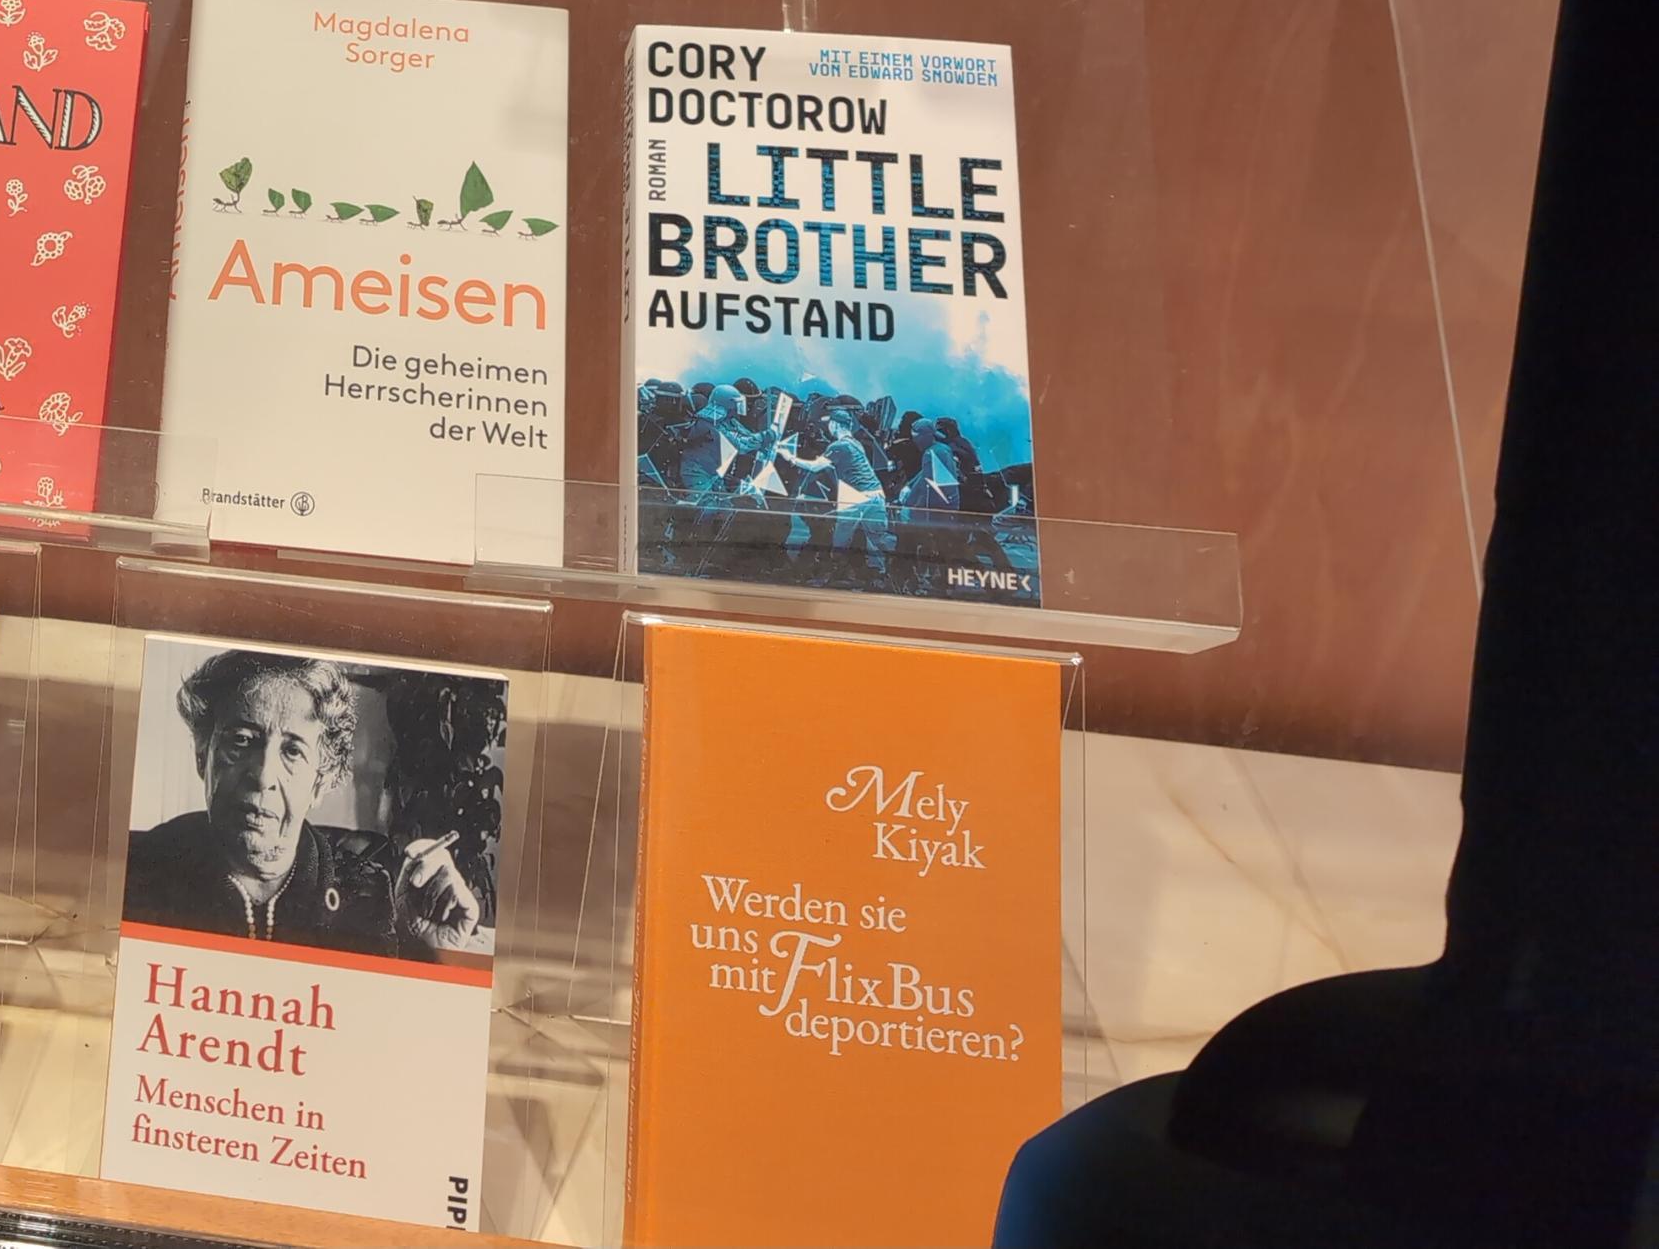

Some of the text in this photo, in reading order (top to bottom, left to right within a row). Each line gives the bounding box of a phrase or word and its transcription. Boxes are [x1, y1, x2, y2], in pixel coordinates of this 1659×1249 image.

[313, 10, 471, 44] Magdalena
[345, 42, 435, 73] Sorger
[647, 41, 767, 82] CORY
[808, 62, 999, 87] VON EDWARD SNOWDEN
[819, 49, 998, 73] MIT EINEM VORWORT
[647, 86, 888, 136] DOCTOROW
[648, 138, 667, 202] ROMAN
[706, 141, 1006, 224] LITTLE
[648, 212, 1009, 300] BROTHER
[207, 238, 547, 330] Ameisen
[648, 288, 896, 343] AUFSTAND
[352, 345, 548, 386] Die geheimen
[324, 373, 548, 418] Herrscherinnen
[429, 416, 548, 450] der Welt
[202, 488, 285, 509] Brandstätter
[947, 567, 1018, 591] HEYNE
[825, 765, 970, 836] Mely
[872, 822, 987, 877] Kiyak
[701, 874, 908, 933] Werden sie
[690, 923, 759, 955] uns
[144, 962, 337, 1031] Hannah
[708, 958, 777, 995] mit
[136, 1012, 307, 1076] Arendt
[785, 998, 1025, 1062] deportieren?
[135, 1073, 325, 1131] Menschen in
[131, 1112, 368, 1179] finsteren Zeiten
[445, 1175, 469, 1231] PIP
